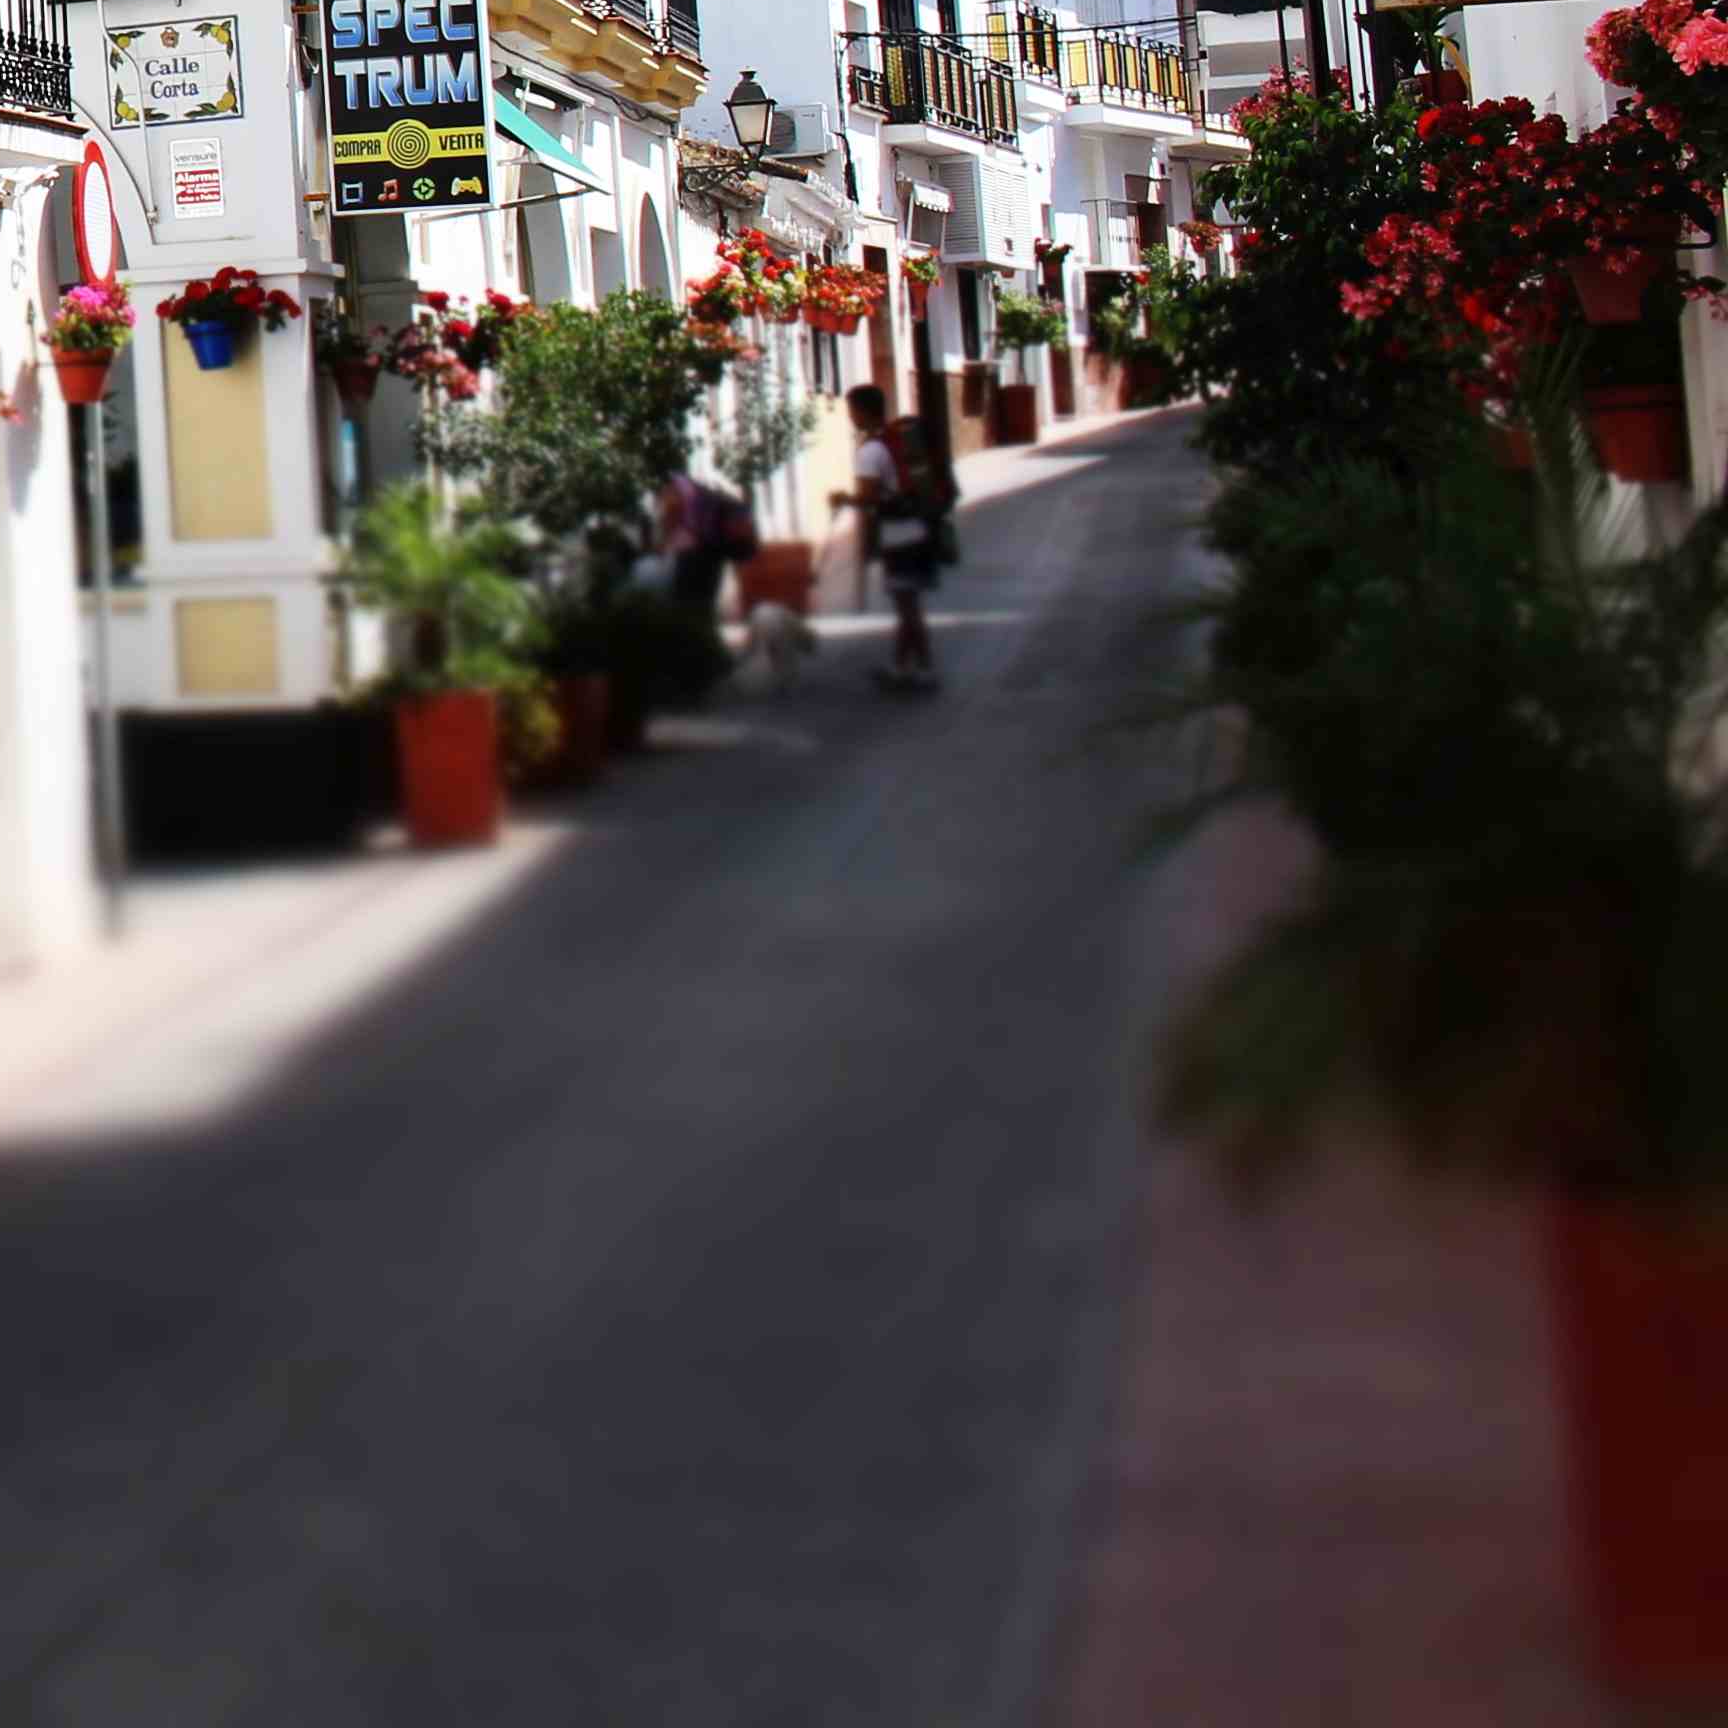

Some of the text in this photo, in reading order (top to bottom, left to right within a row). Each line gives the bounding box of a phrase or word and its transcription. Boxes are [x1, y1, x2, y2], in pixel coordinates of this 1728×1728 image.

[144, 57, 200, 77] Calle
[150, 80, 200, 100] Corta
[334, 51, 479, 110] TRUM
[334, 133, 484, 158] COMPRA VENTA
[176, 173, 219, 183] Alarma
